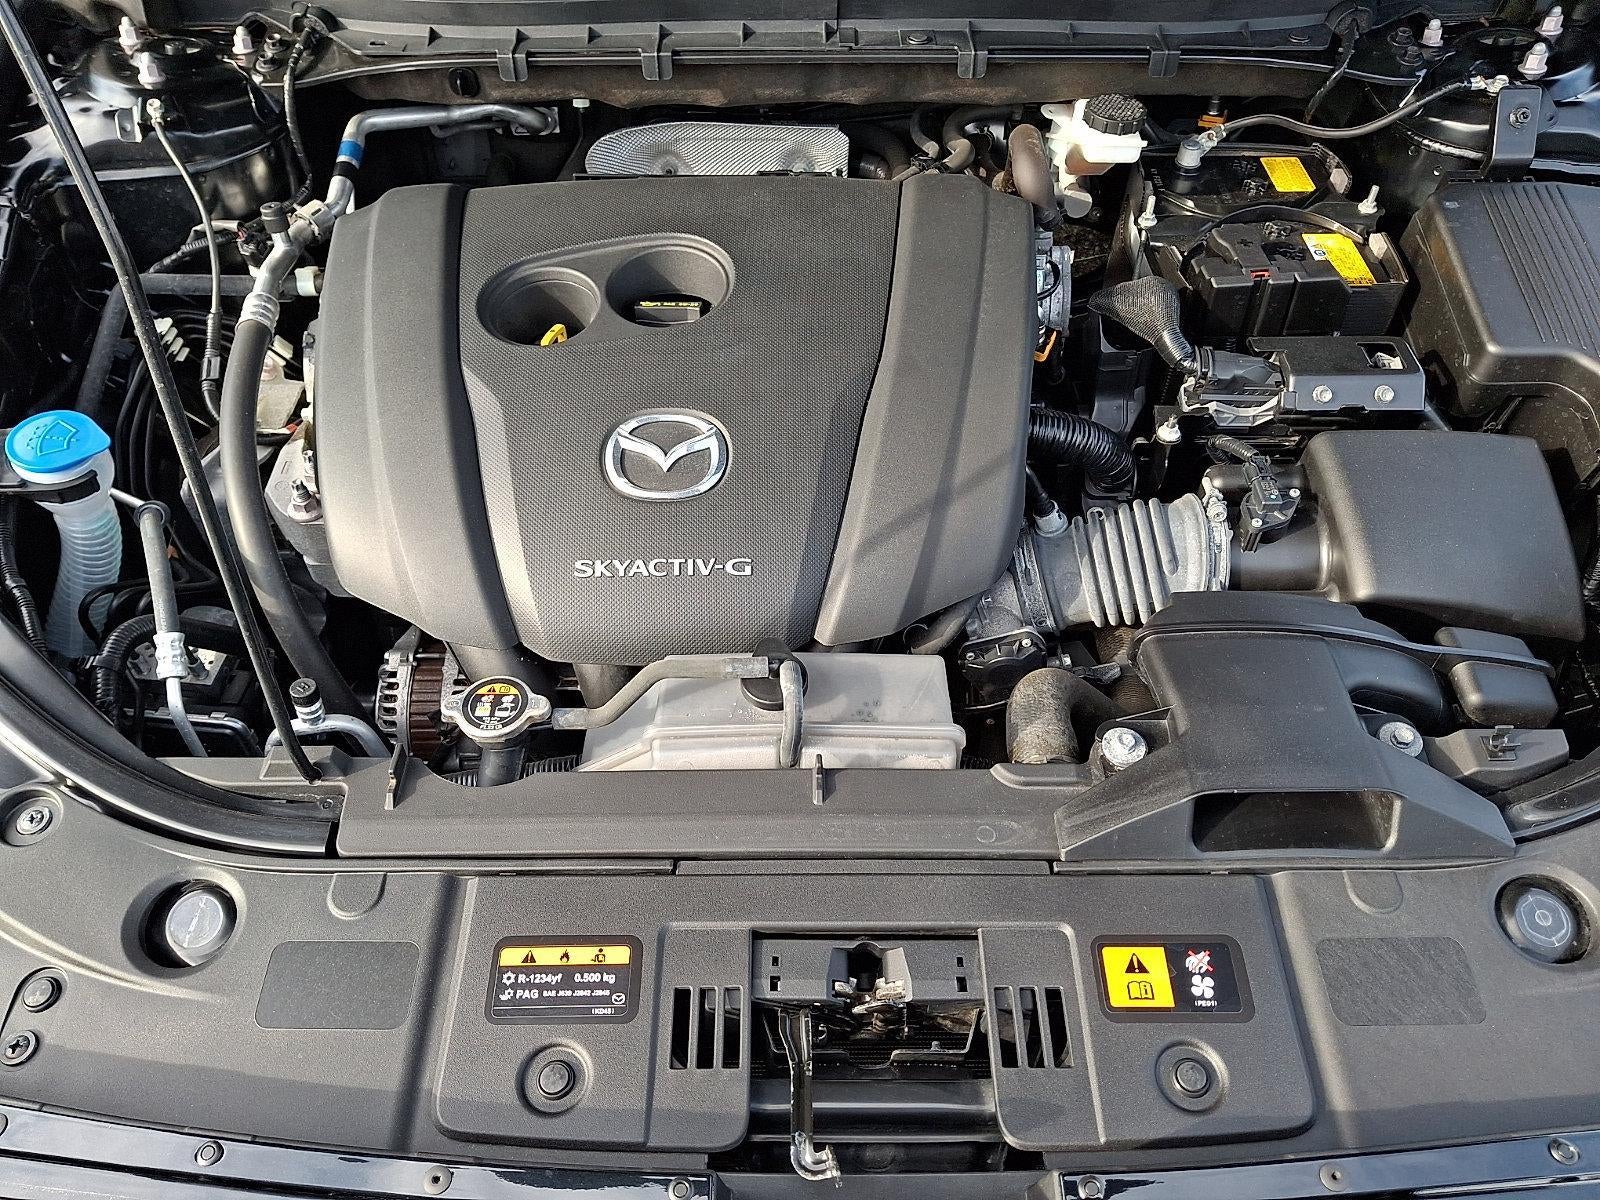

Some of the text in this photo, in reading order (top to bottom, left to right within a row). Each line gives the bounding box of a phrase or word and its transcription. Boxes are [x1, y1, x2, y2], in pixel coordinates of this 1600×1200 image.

[574, 557, 752, 577] SKYACTIV-G
[517, 972, 616, 985] R-1234yf 0.500 kg
[516, 989, 539, 999] PAG
